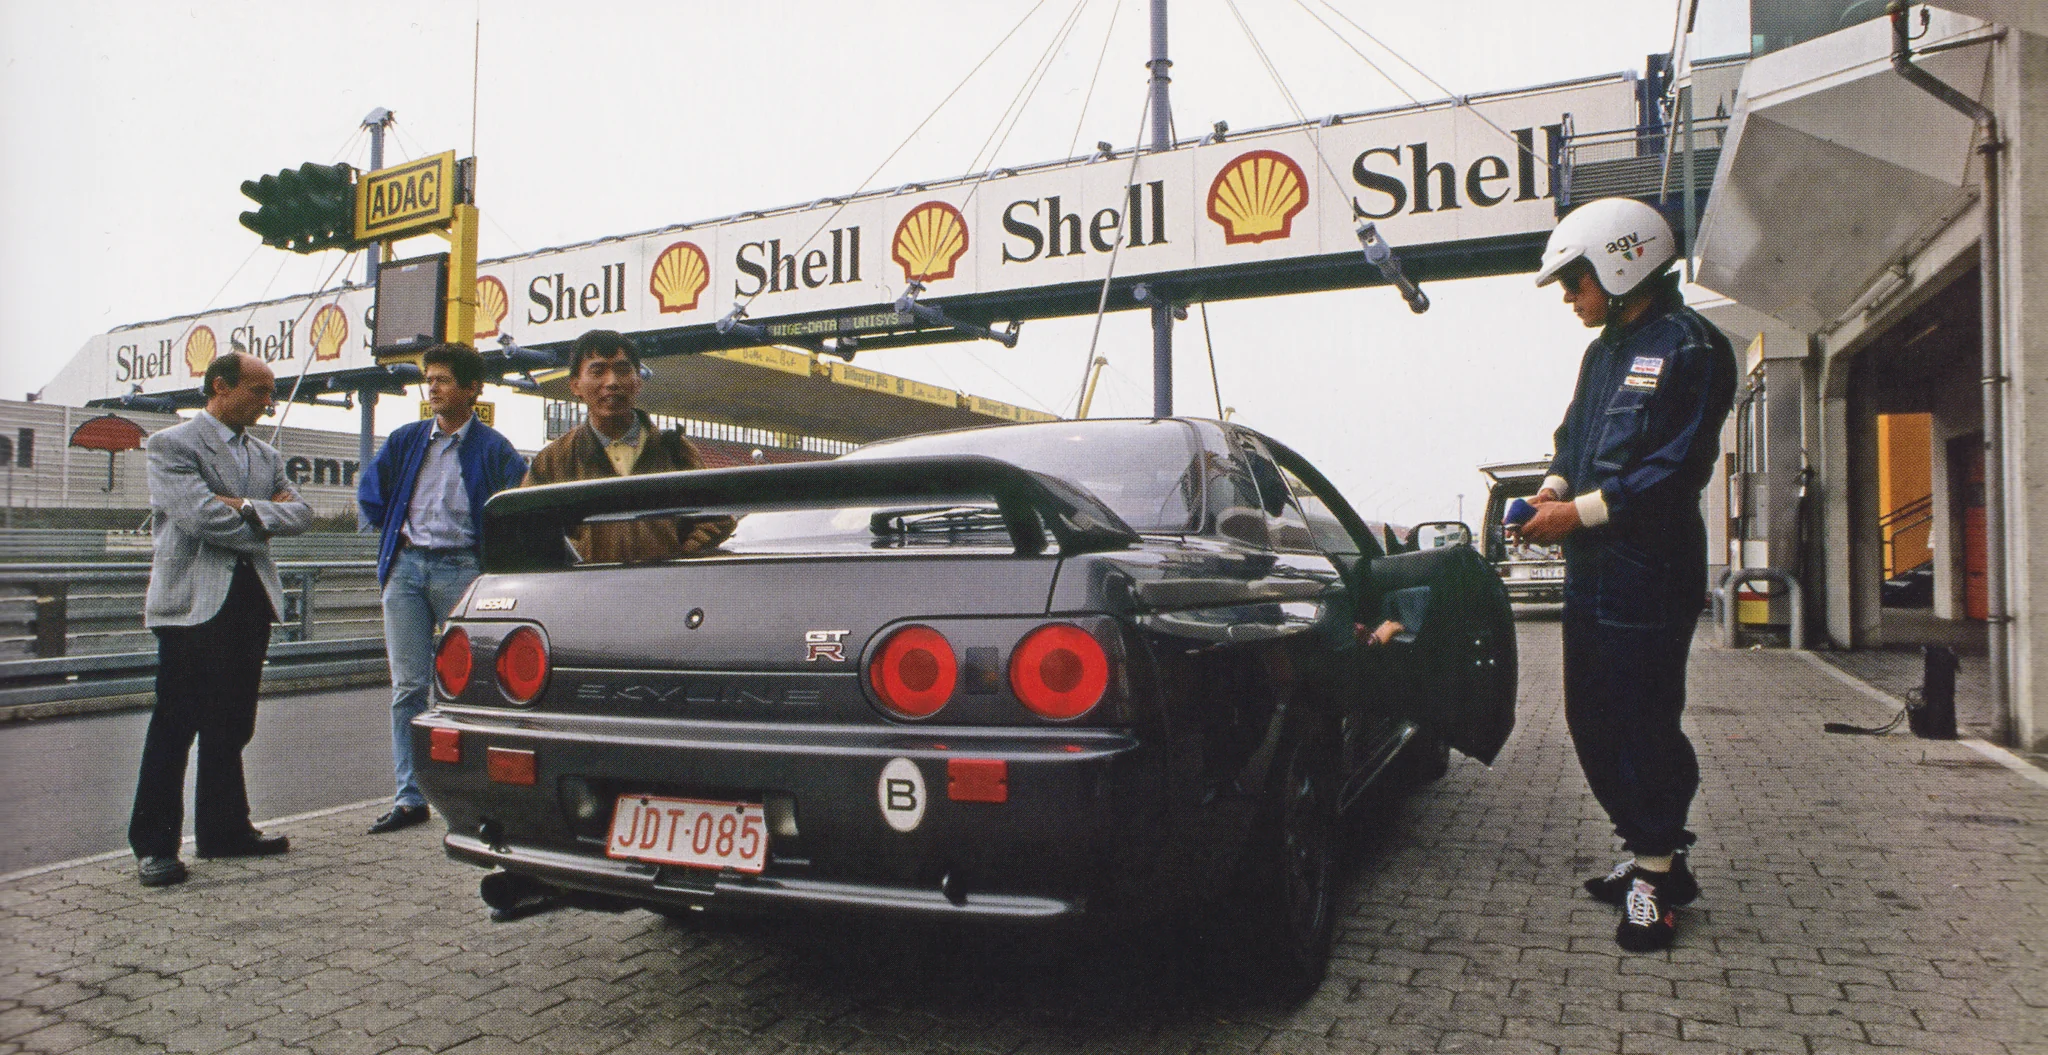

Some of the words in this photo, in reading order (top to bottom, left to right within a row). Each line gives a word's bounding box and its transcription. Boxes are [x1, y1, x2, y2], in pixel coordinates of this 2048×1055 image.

[1352, 122, 1560, 224] Shell
[371, 171, 434, 220] ADAC
[1001, 180, 1168, 265] Shell
[1605, 232, 1638, 254] agv
[734, 226, 862, 298] Shell
[527, 263, 626, 326] Shell
[230, 319, 294, 364] Shell
[853, 313, 899, 329] UNISYS
[116, 339, 171, 382] Shell
[476, 597, 517, 611] NISSAN
[805, 629, 851, 642] GT
[806, 642, 846, 662] R
[886, 777, 918, 812] B
